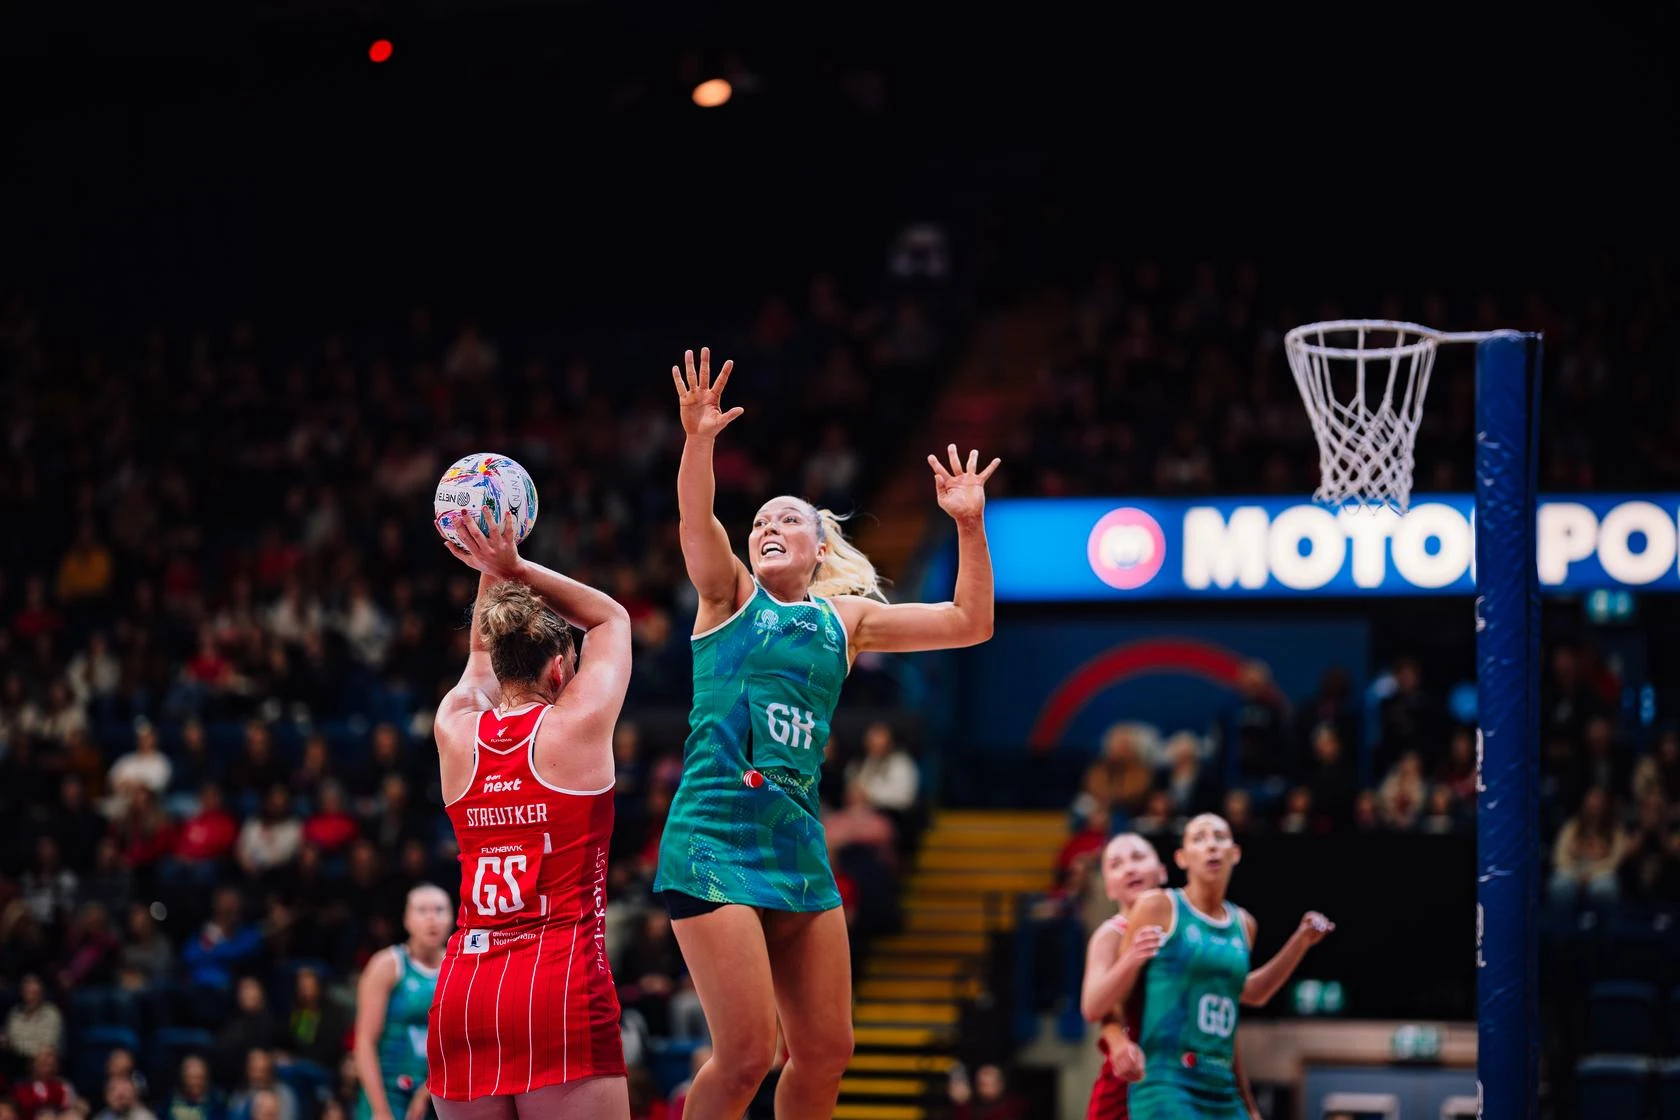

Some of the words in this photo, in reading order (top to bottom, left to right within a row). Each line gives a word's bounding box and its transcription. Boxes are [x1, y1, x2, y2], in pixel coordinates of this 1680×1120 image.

[766, 702, 816, 750] GH
[483, 778, 522, 794] next
[466, 803, 548, 827] STREUTKER
[472, 854, 527, 917] GS
